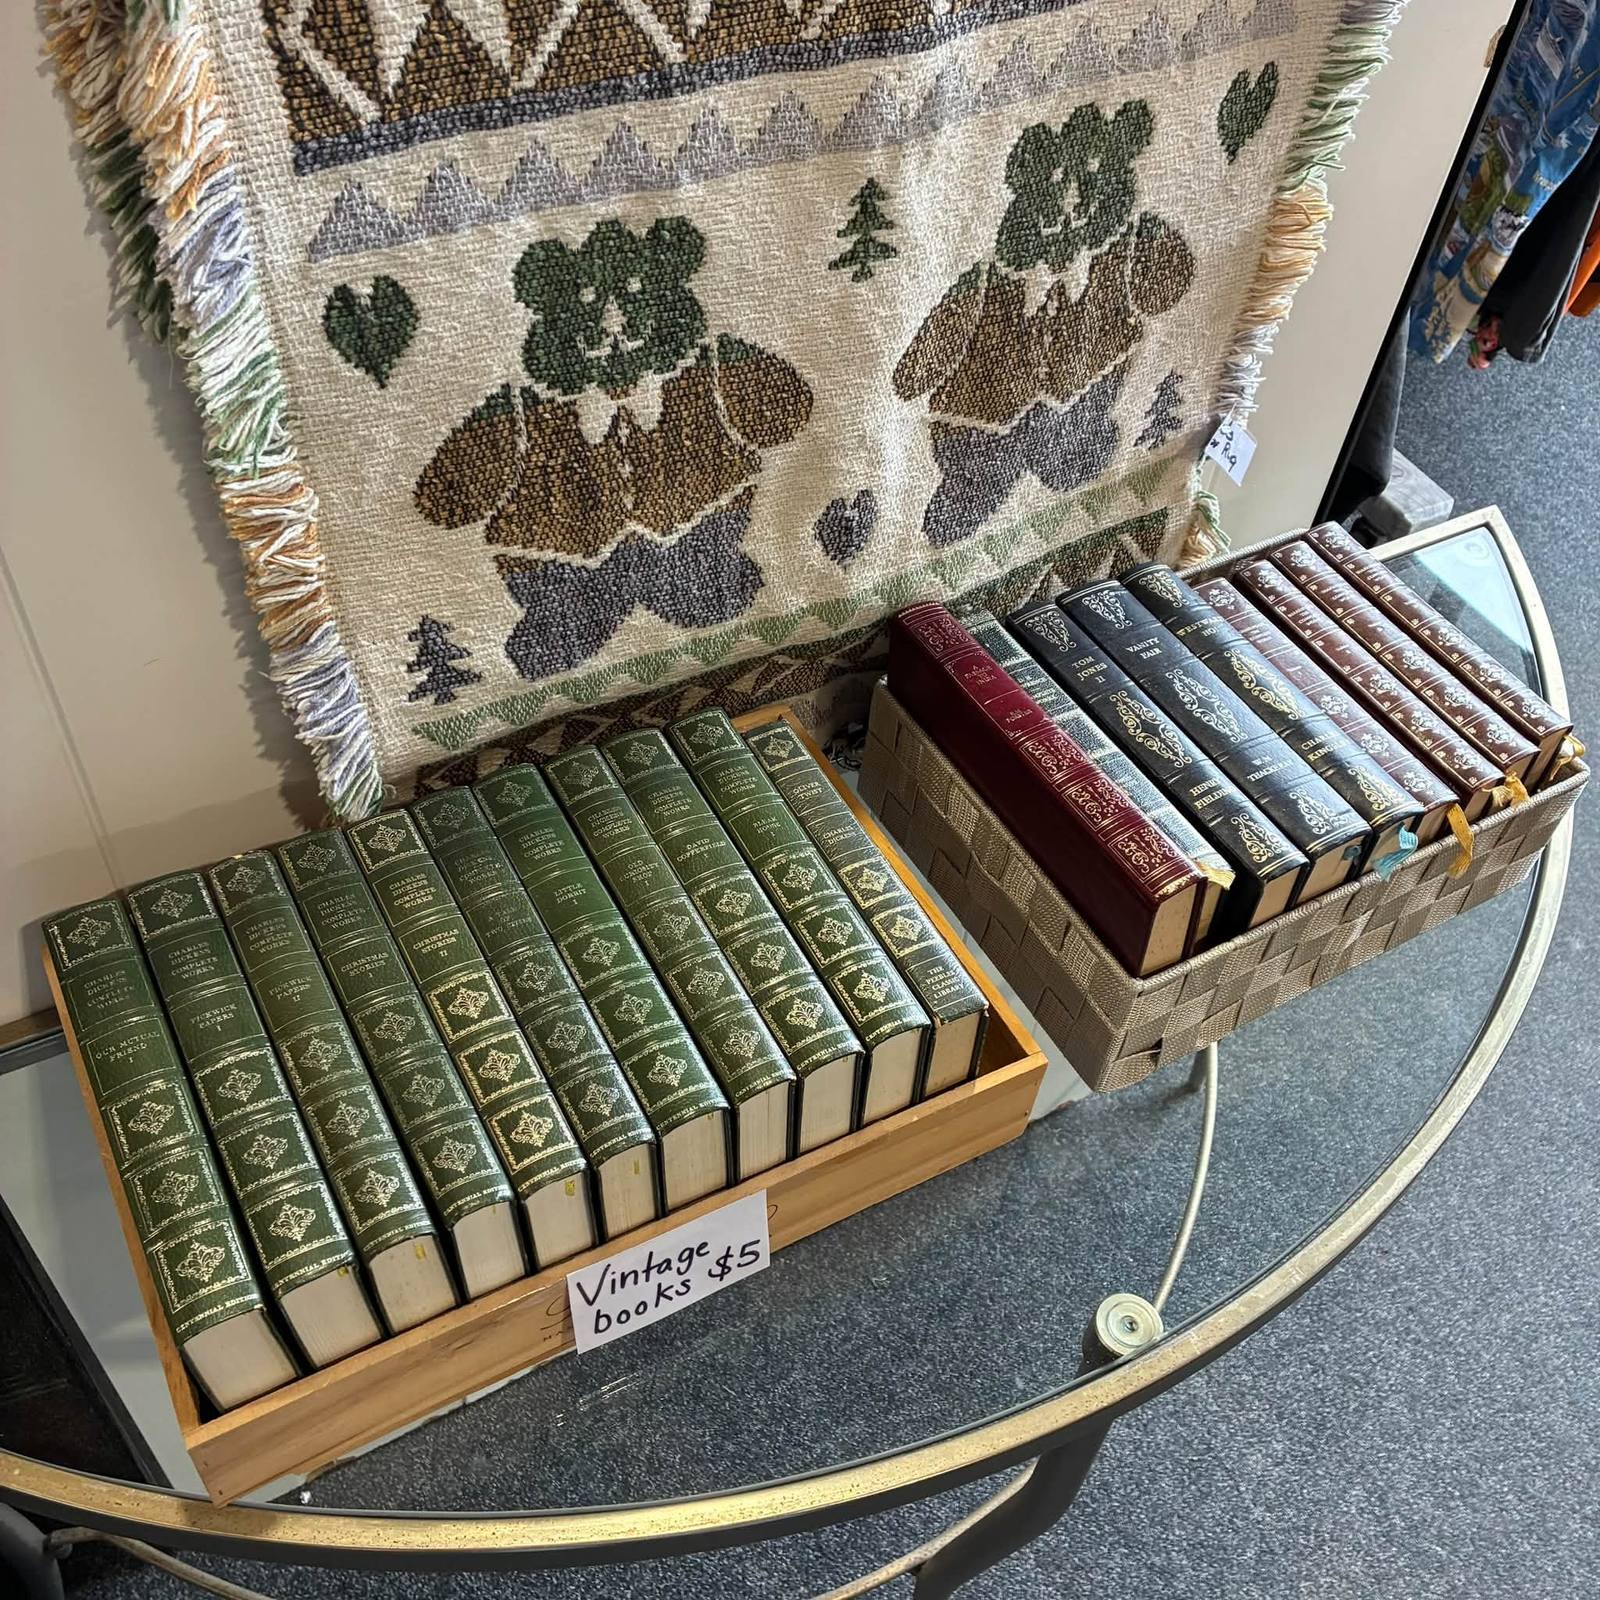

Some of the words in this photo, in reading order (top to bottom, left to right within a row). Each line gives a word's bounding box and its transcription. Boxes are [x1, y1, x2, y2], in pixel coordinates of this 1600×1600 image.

[1125, 636, 1161, 653] VANITY
[1140, 647, 1163, 660] FAIR
[1072, 656, 1095, 670] TOM
[1077, 662, 1108, 682] JONES
[720, 776, 758, 793] COMPLETE
[729, 783, 756, 795] WORKS
[792, 781, 821, 795] OLIVER
[1189, 777, 1221, 798] HENRY
[651, 790, 684, 805] DICKENS
[798, 787, 824, 800] TWIST
[654, 798, 693, 815] COMPLETE
[663, 804, 691, 817] WORKS
[593, 818, 633, 837] COMPLETE
[752, 816, 777, 828] BLEAK
[519, 827, 554, 843] CHARLES
[602, 824, 631, 839] WORKS
[521, 832, 557, 849] DICKENS
[524, 840, 566, 858] COMPLETE
[686, 838, 710, 850] DAVID
[533, 846, 562, 860] WORKS
[676, 840, 727, 863] COPPERFIELD
[627, 859, 644, 870] OLD
[389, 873, 428, 891] CHARLES
[391, 879, 429, 897] DICKENS
[554, 882, 584, 897] LITTLE
[393, 886, 437, 907] COMPLETE
[403, 895, 434, 909] WORKS
[556, 888, 588, 905] DORRIT
[321, 908, 367, 926] COMPLETE
[331, 915, 363, 930] WORKS
[249, 931, 294, 952] COMPLETE
[259, 939, 291, 954] WORKS
[413, 928, 460, 951] CHRISTMAS
[421, 936, 457, 954] STORIES
[170, 948, 212, 966] DICKENS
[341, 951, 389, 973] CHRISTMAS
[170, 956, 219, 977] COMPLETE
[180, 964, 216, 980] WORKS
[349, 960, 387, 978] STORIES
[927, 964, 945, 976] THE
[268, 976, 313, 997] PICKWICK
[931, 974, 961, 991] CLASSIC
[933, 982, 964, 999] LIBRARY
[276, 983, 311, 1001] PAPERS
[190, 1003, 238, 1024] PICKWICK
[120, 1031, 160, 1049] MUTUAL
[837, 1041, 856, 1049] EDIT
[109, 1042, 148, 1063] FRIEND
[771, 1068, 788, 1078] EDIT
[699, 1098, 724, 1109] EDITI
[627, 1126, 652, 1137] EDITI
[482, 1184, 511, 1195] EDITIO
[576, 1241, 710, 1307] Vintage
[708, 1239, 760, 1282] $5
[594, 1278, 691, 1335] books
